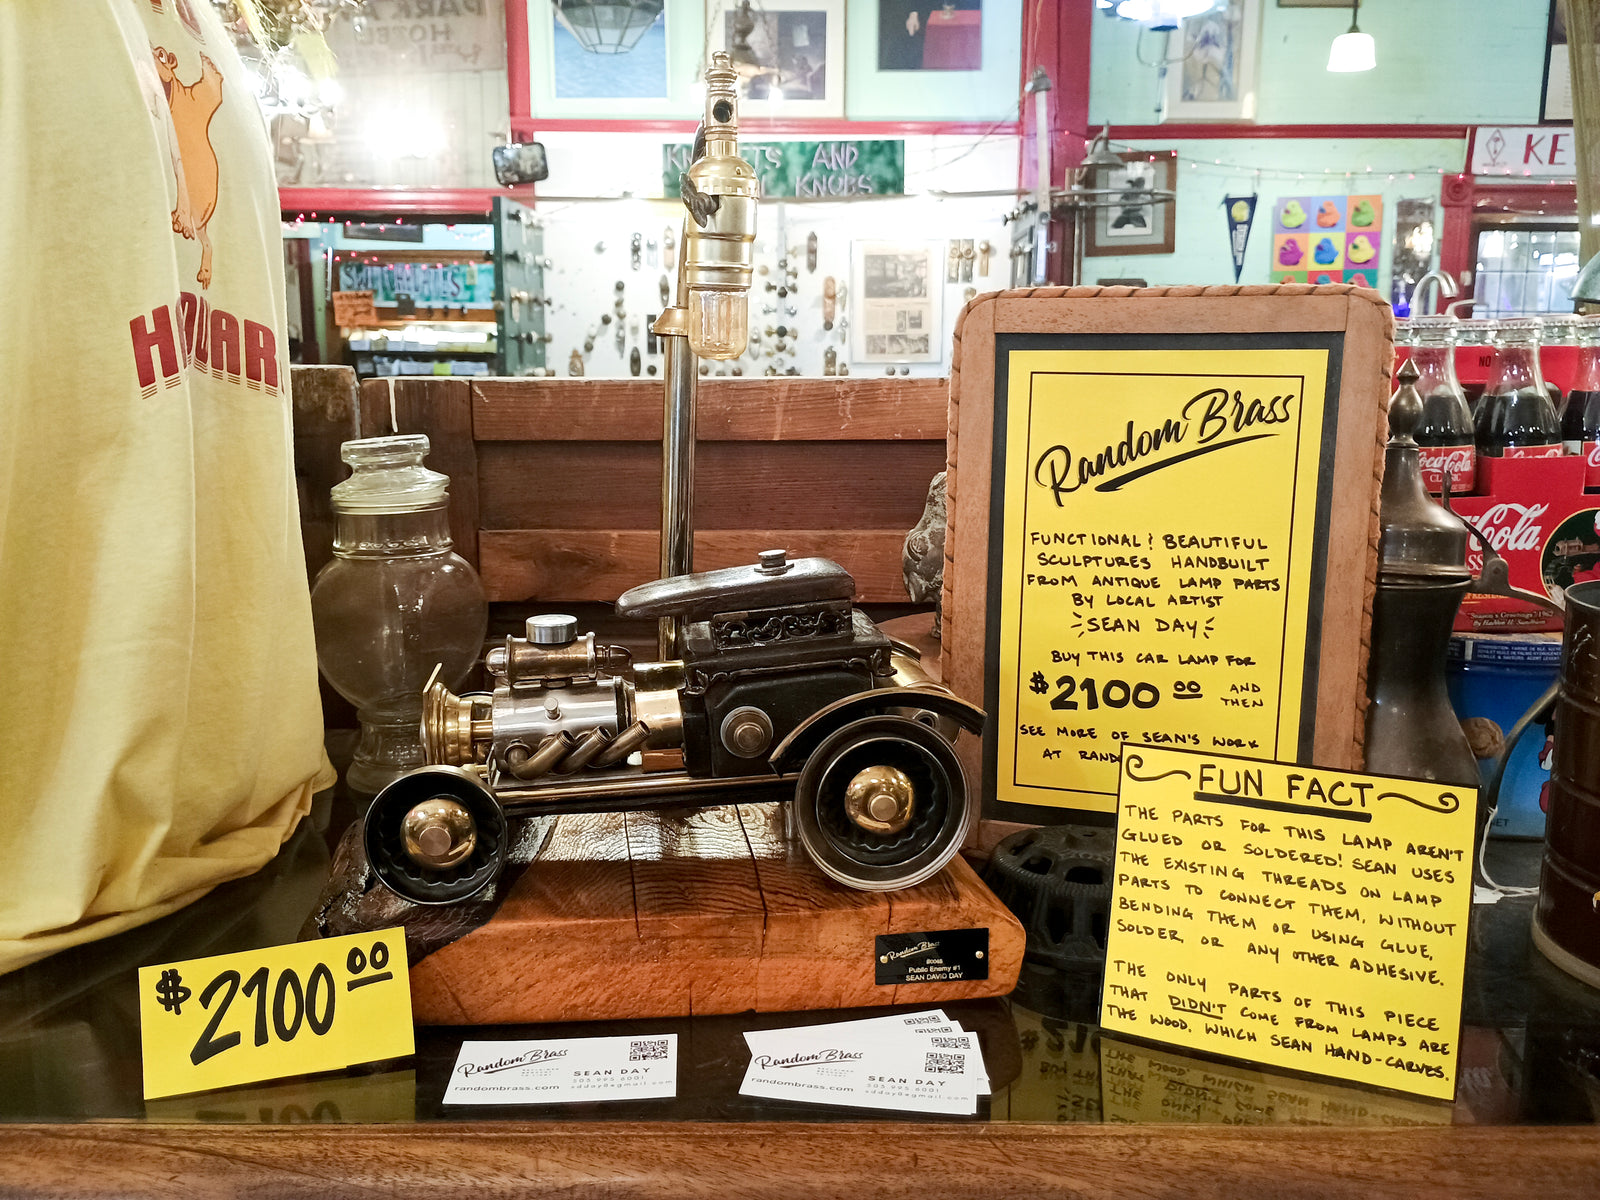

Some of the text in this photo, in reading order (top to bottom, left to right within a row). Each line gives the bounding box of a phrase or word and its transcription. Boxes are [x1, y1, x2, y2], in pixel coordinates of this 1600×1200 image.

[812, 143, 859, 171] AND
[796, 173, 872, 197] KNOBS
[1479, 355, 1491, 367] NO
[1035, 388, 1294, 507] Random Brass
[1031, 532, 1141, 548] FUNCTIONAL
[1163, 534, 1268, 550] BEAUTIFUL
[1037, 553, 1270, 571] SCULPTURES HANDBUILT
[1027, 574, 1280, 591] FROM ANTIQUE LAMP PARTS
[1072, 593, 1223, 608] BY LOCAL ARTIST
[1087, 617, 1198, 638] SEAN DAY
[1051, 650, 1256, 666] BUY THIS CAR LAMP FOR
[1230, 682, 1261, 693] AND
[1220, 697, 1263, 708] THEN
[1020, 724, 1259, 748] SEE MORE OF SEAN'S WORK
[1043, 748, 1061, 760] AT
[1199, 764, 1373, 807] FUN FACT
[1125, 805, 1464, 861] THE PARTS FOR THIS LAMP AREN'T
[1122, 828, 1454, 883] GLUED OR SOLDERED! SEAN USES
[1120, 851, 1442, 908] THE EXISTING THREADS ON LAMP
[1119, 874, 1170, 890] PARTS
[1185, 884, 1203, 895] TO
[1220, 889, 1296, 909] CONNECT
[1379, 914, 1456, 936] WITHOUT
[1119, 897, 1433, 960] BENDING THEM OR USING GLUE,
[1117, 919, 1444, 986] SOLDER, OR ANY OTHER ADHESIVE.
[155, 941, 391, 1066] $2100 00
[1113, 960, 1440, 1031] THE ONLY PARTS OF THIS PIECE
[1109, 984, 1450, 1055] THAT DIDN'T COME FROM LAMPS ARE
[1107, 1004, 1137, 1020] THE
[1205, 1023, 1256, 1042] WHICH
[1270, 1034, 1312, 1053] SEAN
[1325, 1043, 1449, 1081] HAND-CARVES.
[457, 1057, 523, 1078] Random
[523, 1048, 569, 1062] Brass
[621, 1067, 651, 1075] DAY
[754, 1048, 864, 1070] Random Brass
[751, 1077, 854, 1093] randombrass.com
[868, 1075, 907, 1084] SEAN
